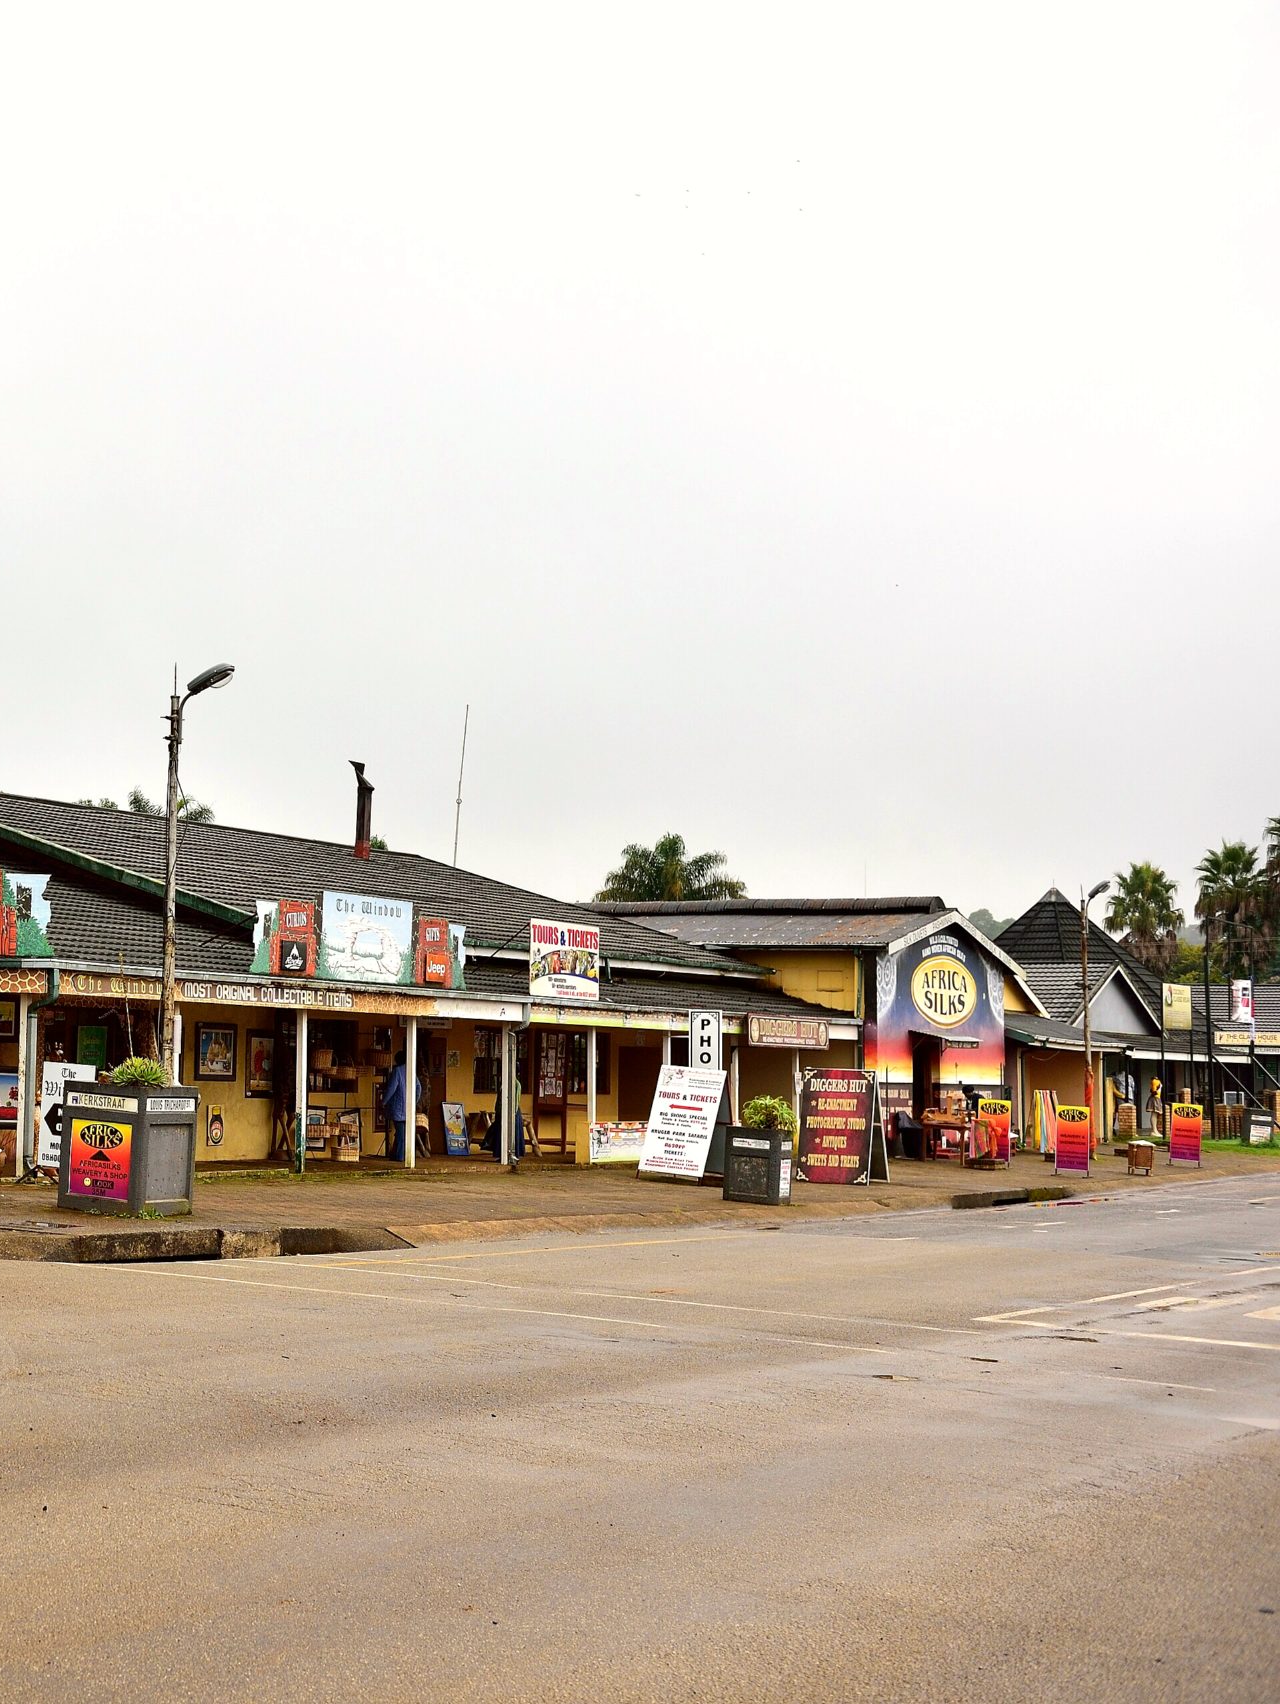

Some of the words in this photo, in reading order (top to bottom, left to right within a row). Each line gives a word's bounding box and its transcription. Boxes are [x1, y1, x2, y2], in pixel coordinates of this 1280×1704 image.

[336, 898, 355, 914] The
[361, 901, 402, 918] Window
[286, 911, 307, 928] CURIOS
[532, 924, 559, 945] TOURS
[560, 931, 566, 946] &
[567, 928, 598, 950] TICKETS
[427, 960, 446, 976] Jeep
[76, 974, 102, 992] The
[922, 969, 967, 993] AFRICA
[184, 981, 213, 998] MOST
[216, 984, 258, 1002] ORIGINAL
[260, 987, 324, 1006] COLLECTABLE
[325, 991, 352, 1008] ITEMS
[924, 990, 965, 1016] SILKS
[759, 1019, 797, 1037] DIGGERS
[800, 1022, 818, 1038] HUT
[699, 1018, 712, 1065] PHO
[61, 1067, 77, 1080] The
[810, 1079, 848, 1092] DIGGERS
[849, 1079, 867, 1093] HUT
[79, 1094, 126, 1109] KERKSTRAAT
[150, 1099, 162, 1110] LOUIS
[658, 1091, 680, 1100] TOURS
[690, 1094, 717, 1103] TICKETS
[818, 1098, 858, 1111] RE-ENACTMENT
[806, 1116, 846, 1129] PHOTOGRAPHIC
[847, 1118, 866, 1131] STUDIO
[81, 1124, 123, 1140] AFRICA
[84, 1134, 122, 1149] SILKS
[822, 1135, 847, 1150] ANTIQUES
[79, 1160, 121, 1171] AFRICASILKS
[807, 1154, 827, 1166] SWEETS
[828, 1155, 839, 1167] AND
[840, 1155, 860, 1168] TREATS
[73, 1168, 102, 1178] WEAVERY
[110, 1171, 127, 1180] SHOP
[91, 1188, 106, 1196] 35M
[94, 1180, 113, 1189] LOOK
